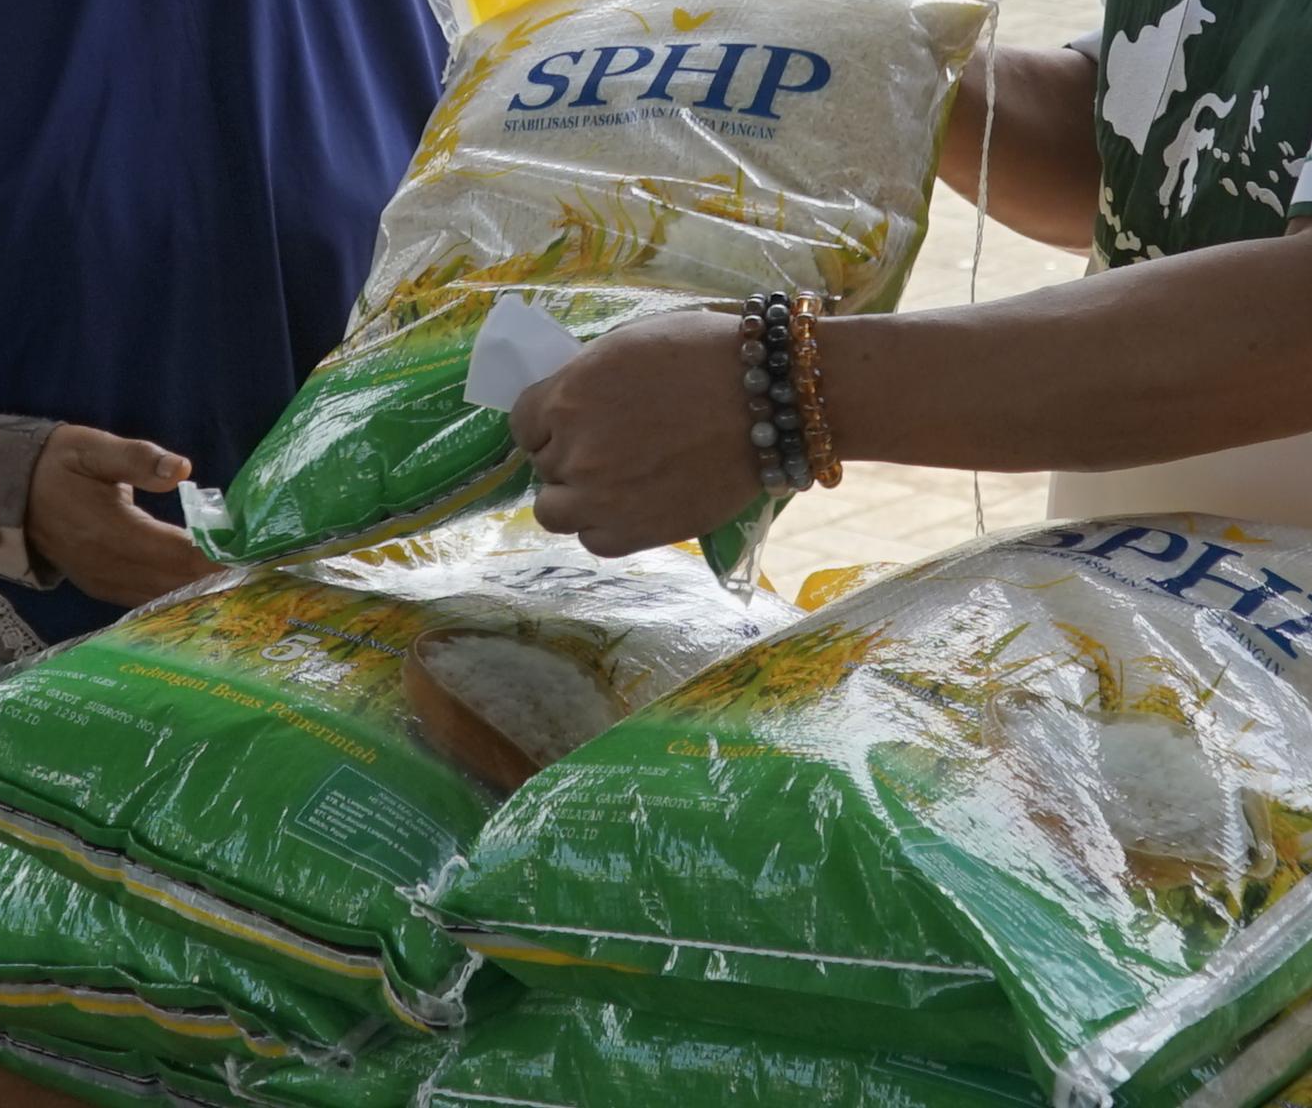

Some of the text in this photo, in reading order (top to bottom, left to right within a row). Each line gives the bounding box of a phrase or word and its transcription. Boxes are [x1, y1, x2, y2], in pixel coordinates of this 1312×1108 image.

[507, 43, 832, 121] SPHP
[503, 115, 579, 133] STABILISASI
[582, 110, 636, 127] PASOKAN
[720, 120, 776, 140] PANGAN
[260, 634, 322, 662] 5
[83, 699, 133, 724] SUBROTO
[118, 662, 209, 692] Cadangan
[209, 683, 266, 709] Beras
[266, 700, 379, 765] Pemerintah
